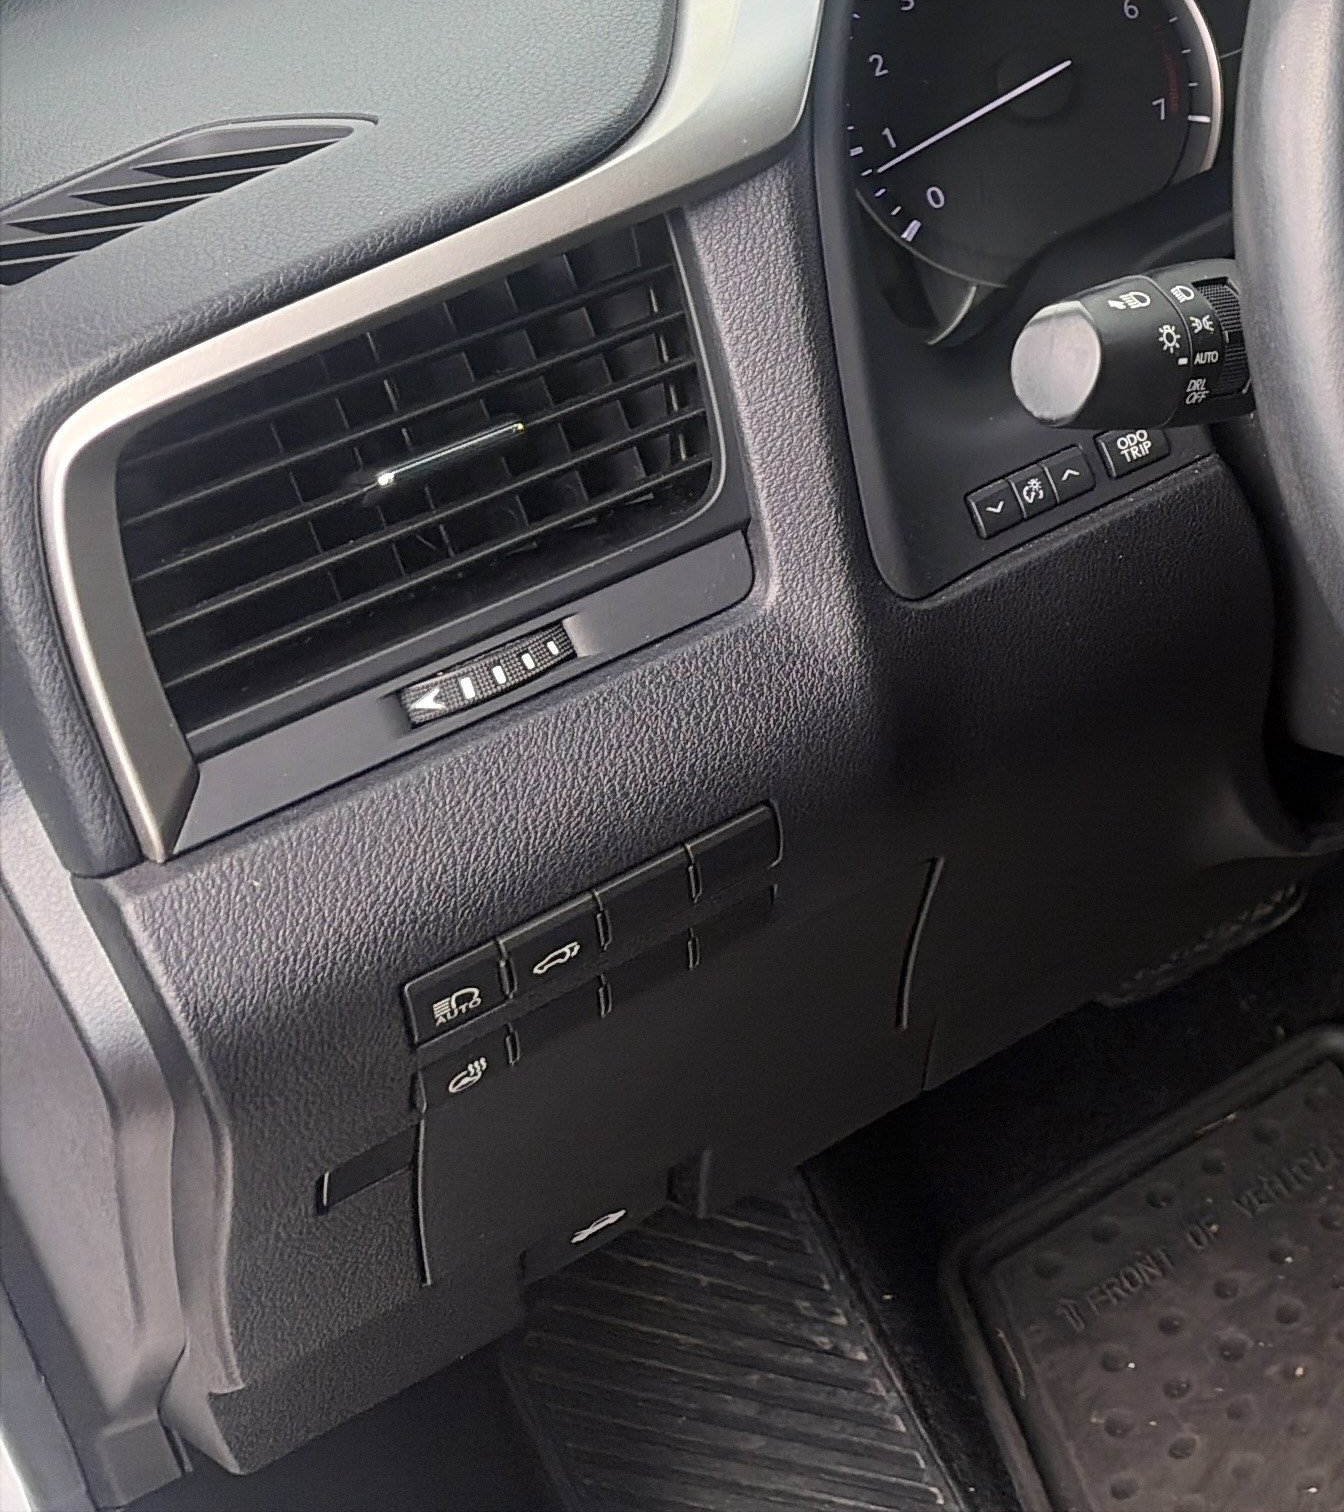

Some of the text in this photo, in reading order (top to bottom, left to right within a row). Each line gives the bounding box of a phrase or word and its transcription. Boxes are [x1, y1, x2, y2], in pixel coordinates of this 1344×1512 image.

[868, 54, 889, 77] 2
[1152, 97, 1166, 120] 7
[881, 127, 897, 149] 1
[926, 186, 945, 209] 0
[1193, 350, 1219, 366] AUTO
[1186, 377, 1207, 393] DRL
[1185, 389, 1210, 405] OFF
[1116, 429, 1149, 450] ODO
[1119, 439, 1152, 464] TRIP
[435, 997, 482, 1027] AUTO
